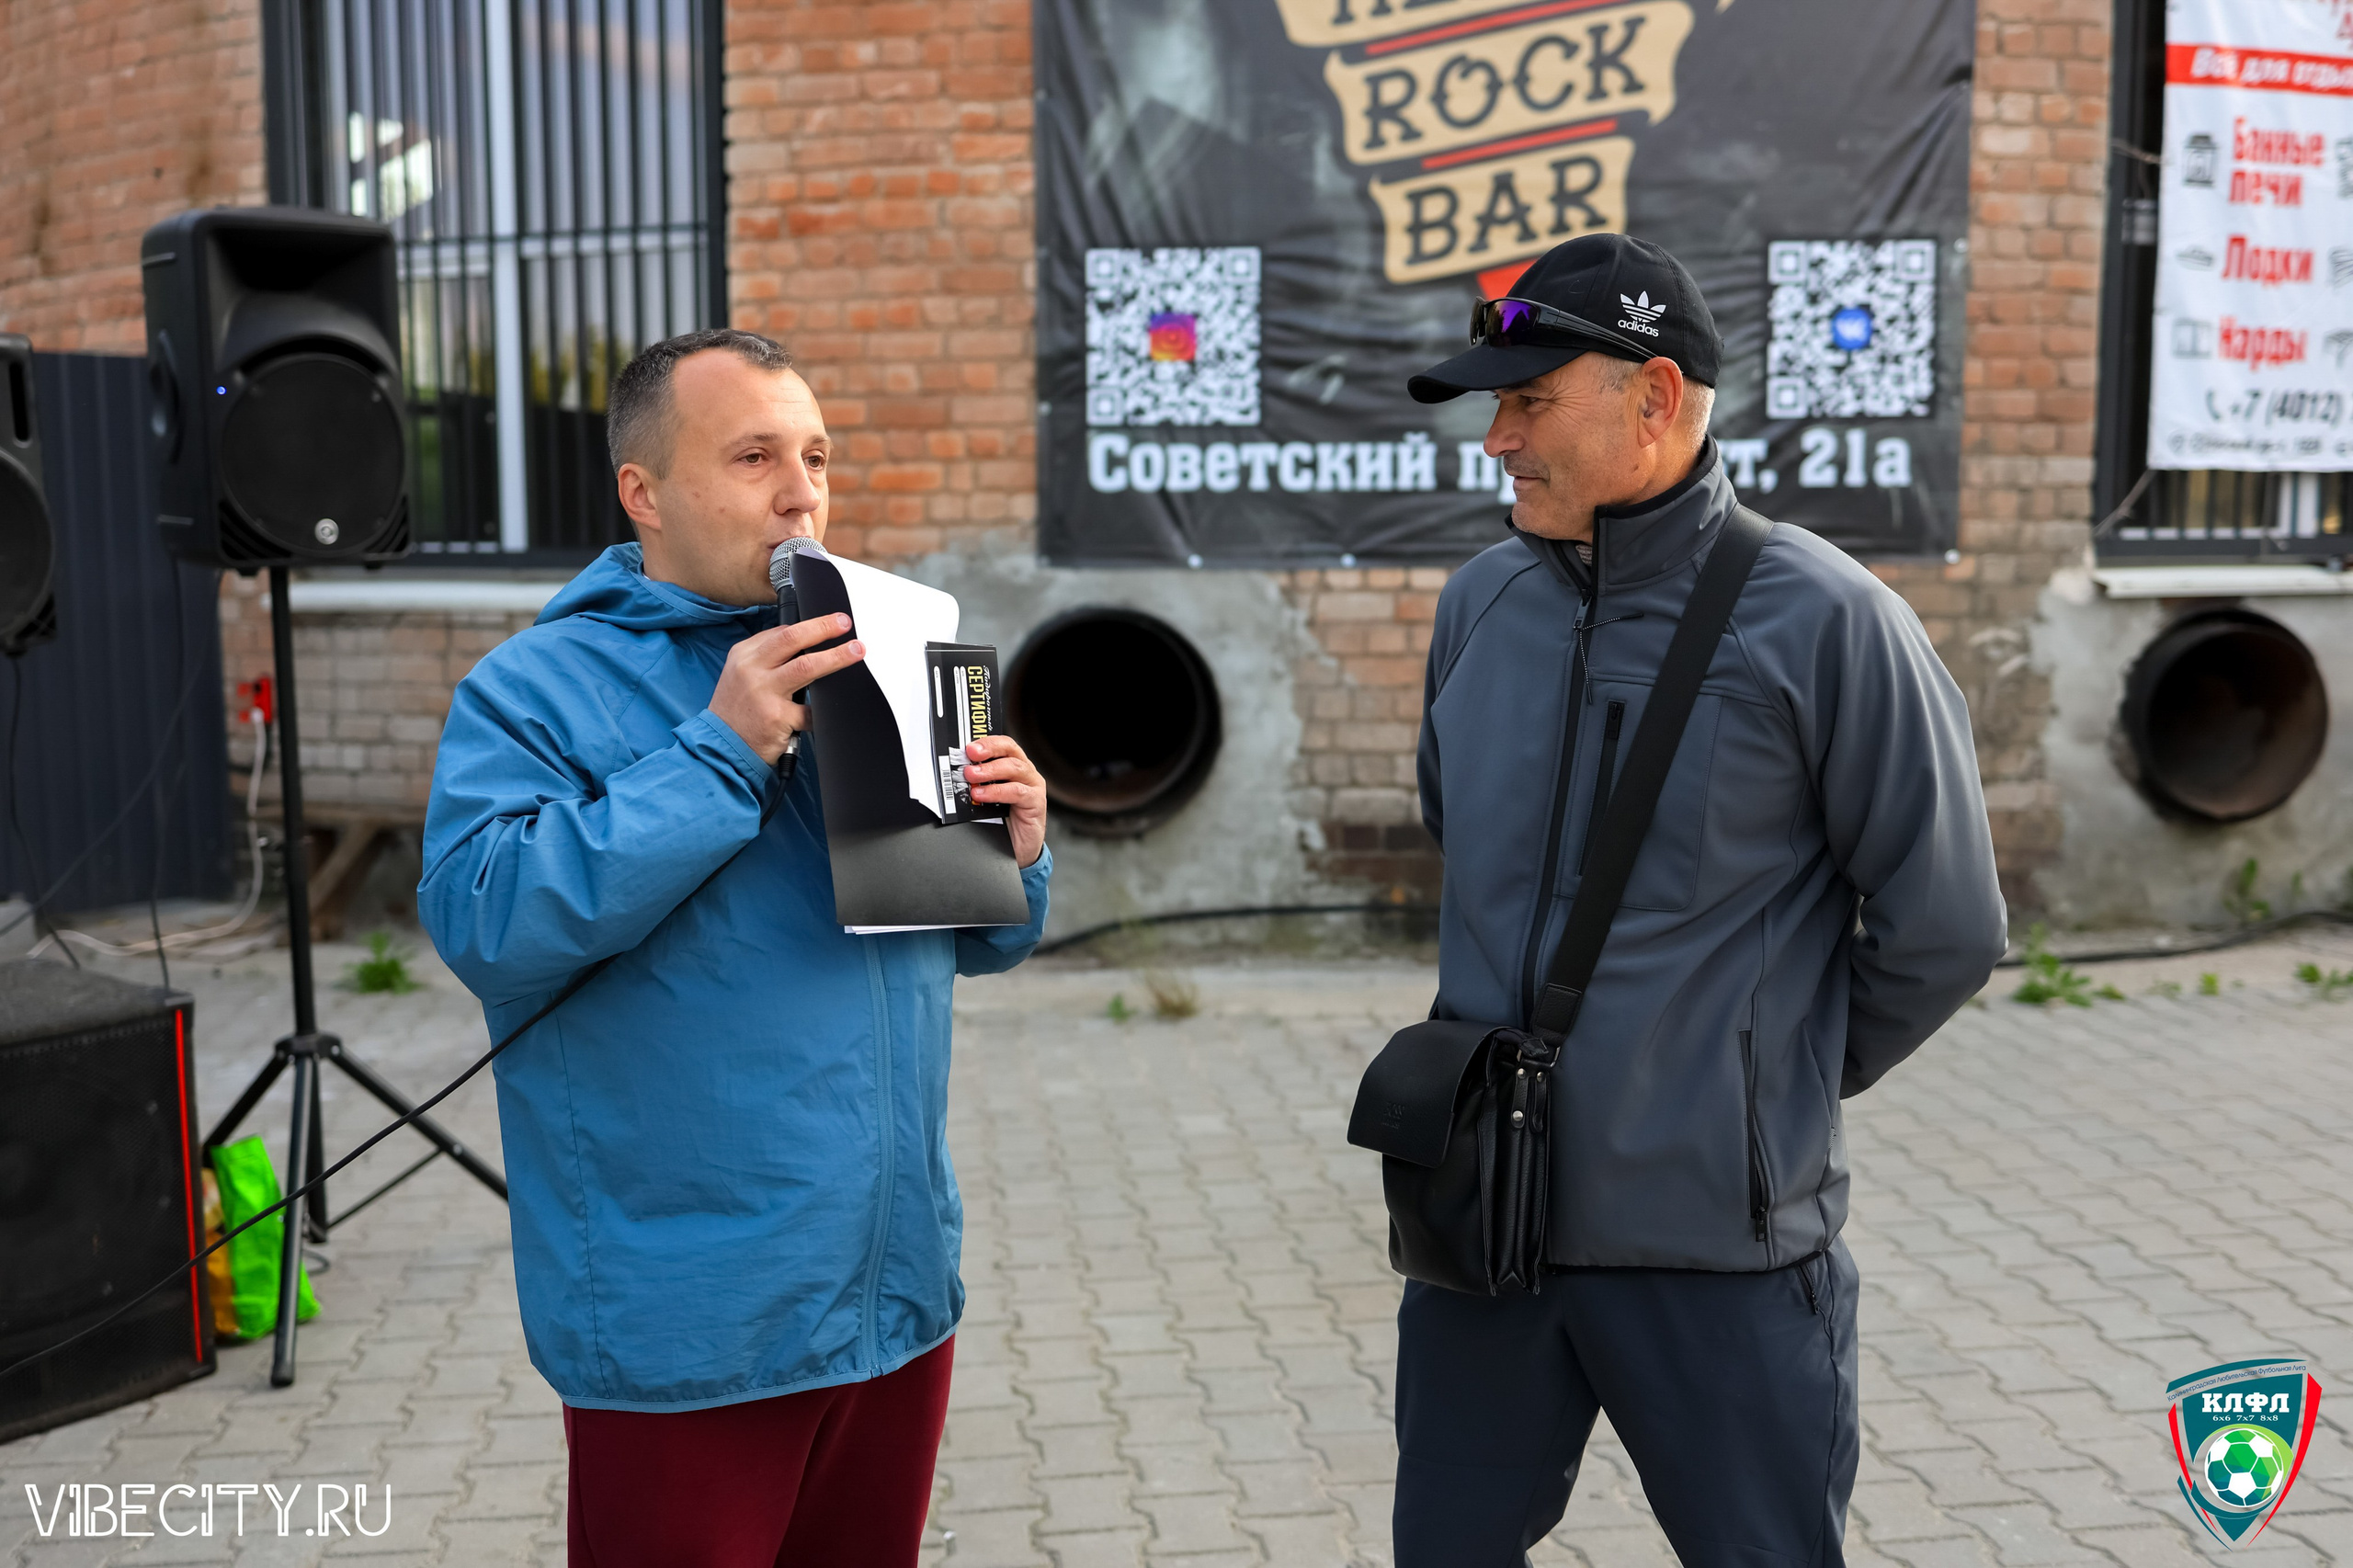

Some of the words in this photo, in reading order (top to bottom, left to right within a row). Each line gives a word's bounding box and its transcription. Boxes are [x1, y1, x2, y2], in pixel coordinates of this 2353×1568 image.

[1361, 17, 1646, 151] ROCK
[2233, 116, 2325, 166] Банные
[1403, 154, 1608, 267] BAR
[2222, 233, 2313, 289] Лодки
[1618, 318, 1659, 337] adidas
[2219, 315, 2308, 371] Нарды
[1087, 431, 1438, 493] Советский
[967, 665, 988, 740] СЕРТИФИ
